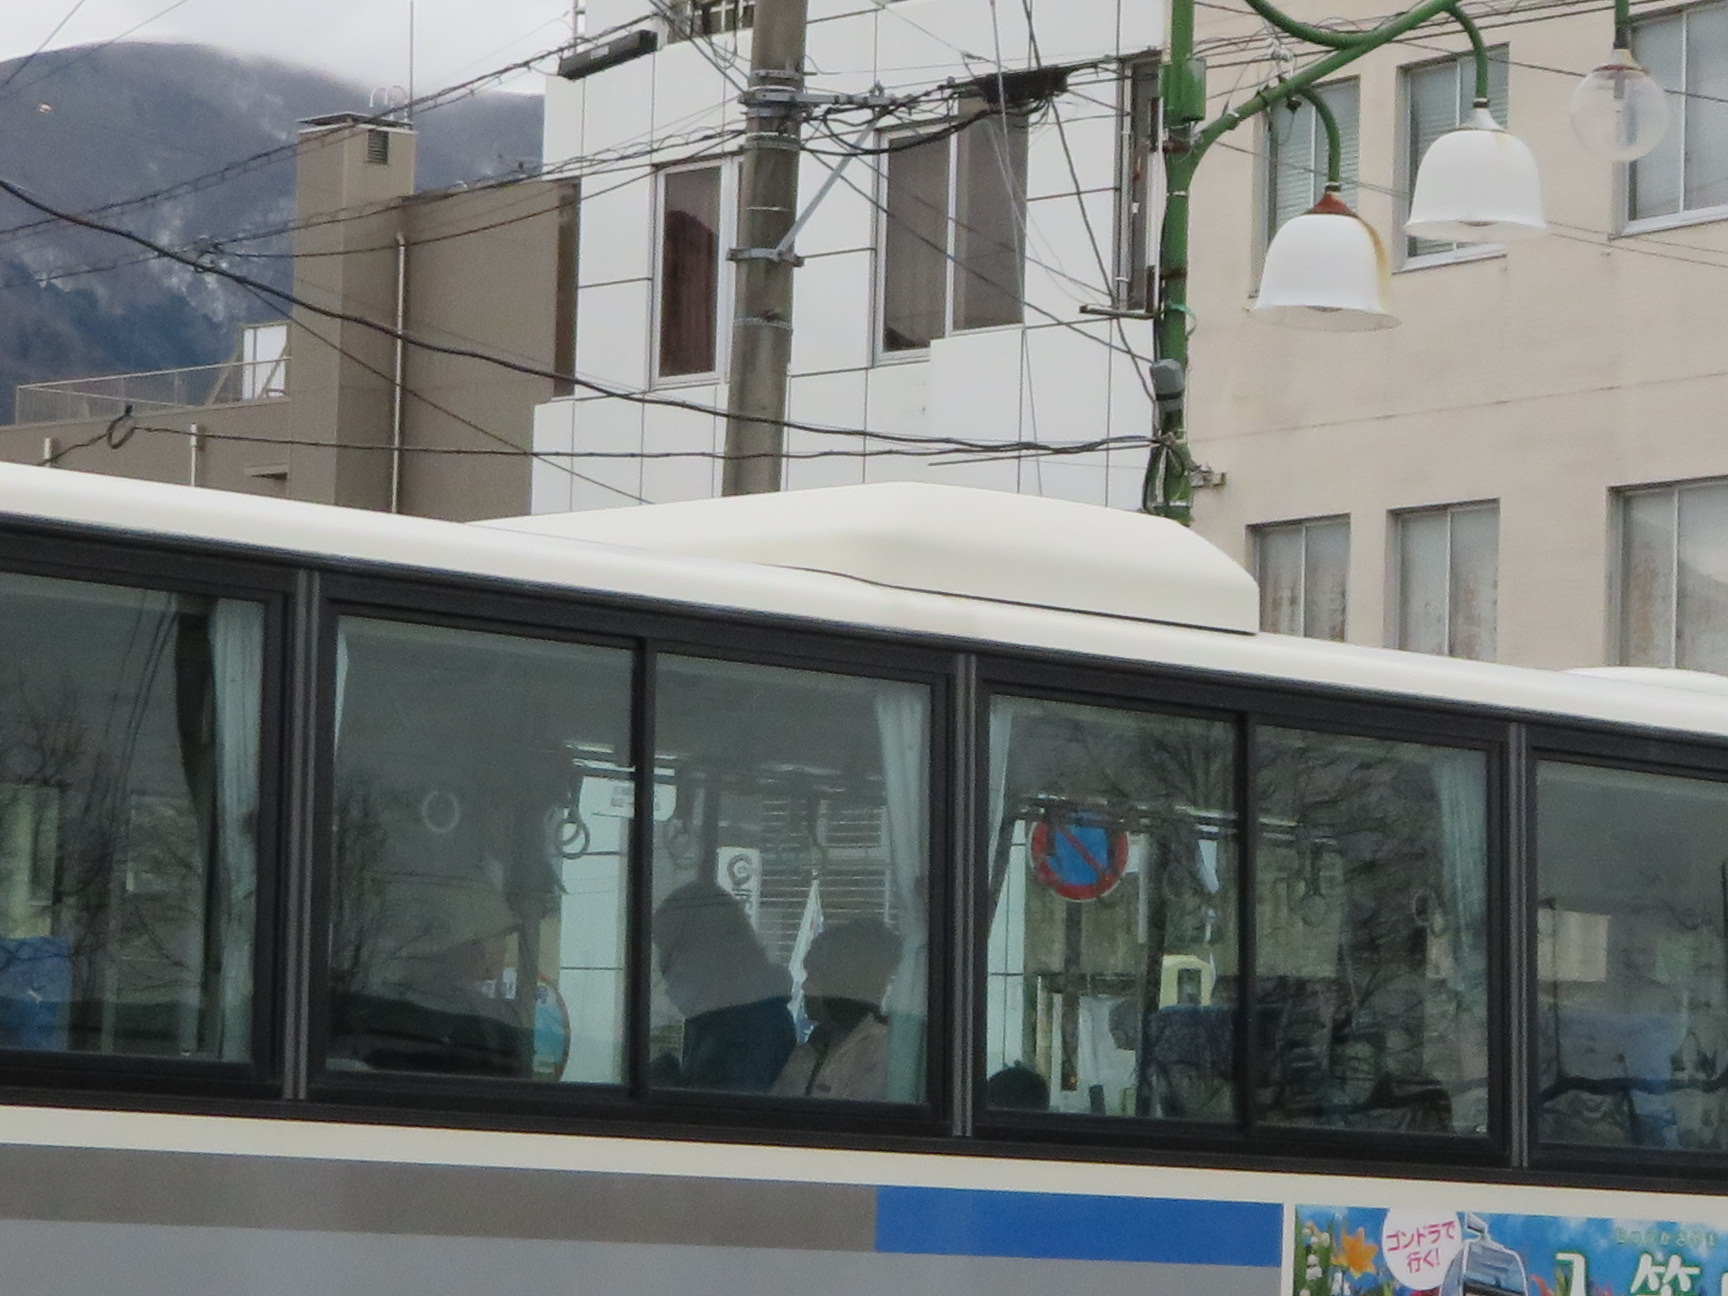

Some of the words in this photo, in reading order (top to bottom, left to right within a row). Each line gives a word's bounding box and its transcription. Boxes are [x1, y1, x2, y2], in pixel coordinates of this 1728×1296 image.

[1386, 1220, 1457, 1252] ゴンドラで
